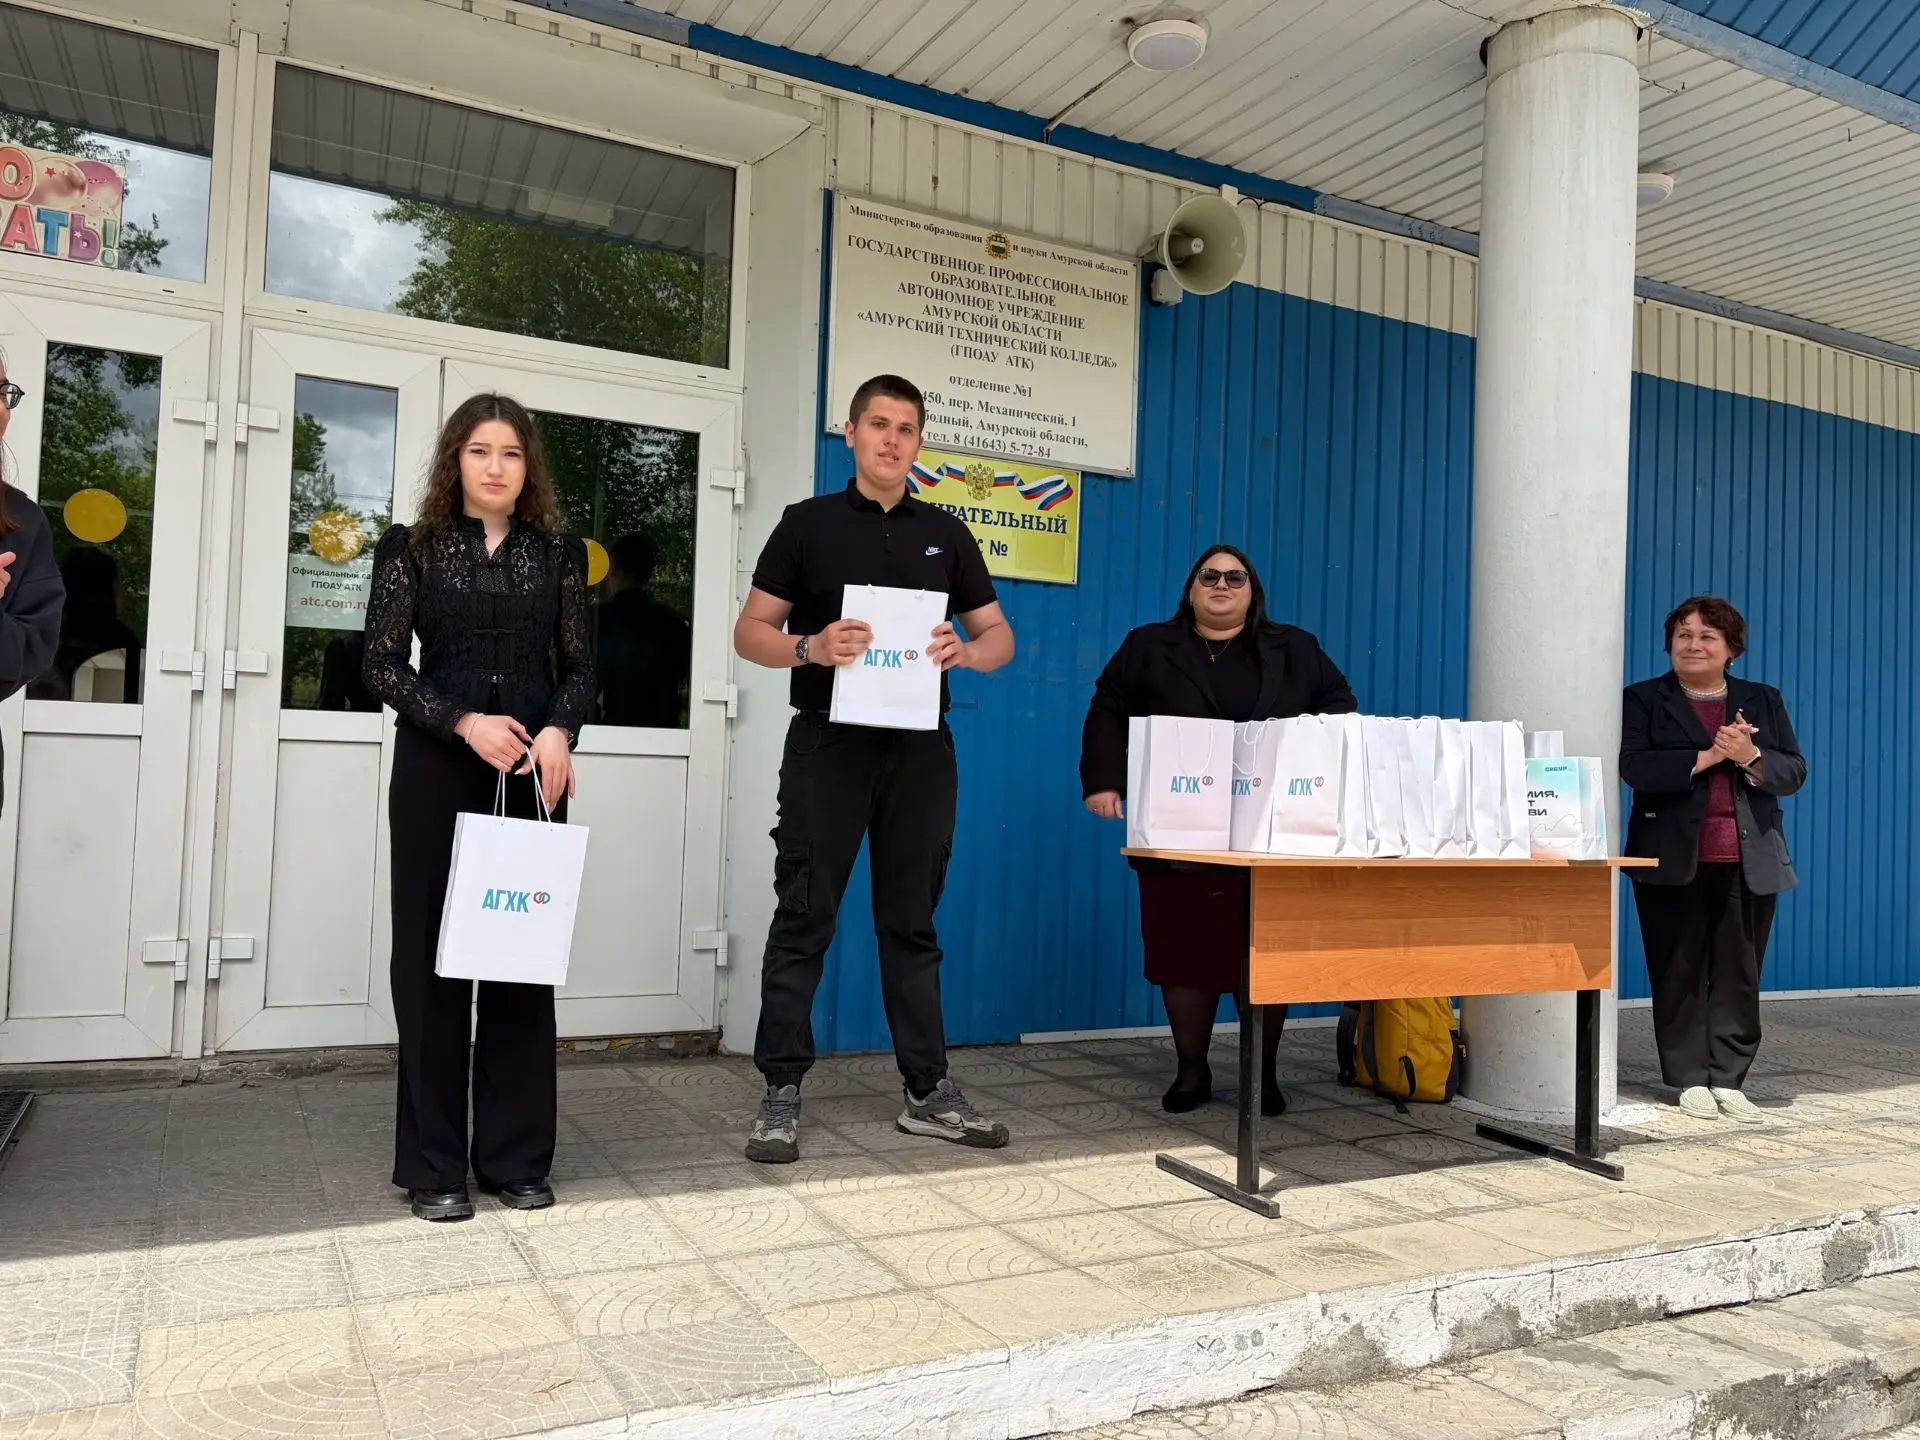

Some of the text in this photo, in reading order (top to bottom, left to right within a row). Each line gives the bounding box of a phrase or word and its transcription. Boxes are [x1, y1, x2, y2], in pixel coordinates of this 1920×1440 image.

[0, 203, 117, 266] АТЬ!
[849, 204, 1129, 277] Министерство образования и науки Амурской области
[847, 234, 1129, 306] ГОСУДАРСТВЕННОЕ ПРОФЕССИОНАЛЬНОЕ
[930, 270, 1057, 307] ОБРАЗОВАТЕЛЬНОЕ
[897, 281, 1086, 330] АВТОНОМНОЕ УЧРЕЖДЕНИЕ
[922, 304, 1062, 342] АМУРСКОЙ ОБЛАСТИ
[857, 310, 1117, 369] «АМУРСКИЙ ТЕХНИЧЕСКИЙ КОЛЛЕДЖ»
[950, 344, 1035, 372] (ГПОАУ АТК)
[949, 375, 1032, 398] отделение №1
[948, 398, 974, 412] пер.
[977, 400, 1068, 426] Механический,
[1071, 416, 1076, 427] 1
[926, 432, 1051, 458] тел. 8 (41643) 5-72-84
[976, 419, 1036, 438] Амурской
[1039, 430, 1088, 448] области,
[930, 502, 1068, 535] РАТЕЛЬНЫЙ
[989, 539, 1008, 557] №
[292, 566, 360, 580] Официальный
[311, 580, 362, 591] ГПОАУ АТК
[863, 648, 903, 669] АГХК
[1170, 775, 1201, 794] АГХК
[1287, 778, 1313, 796] АГХК
[481, 888, 531, 913] АГХК
